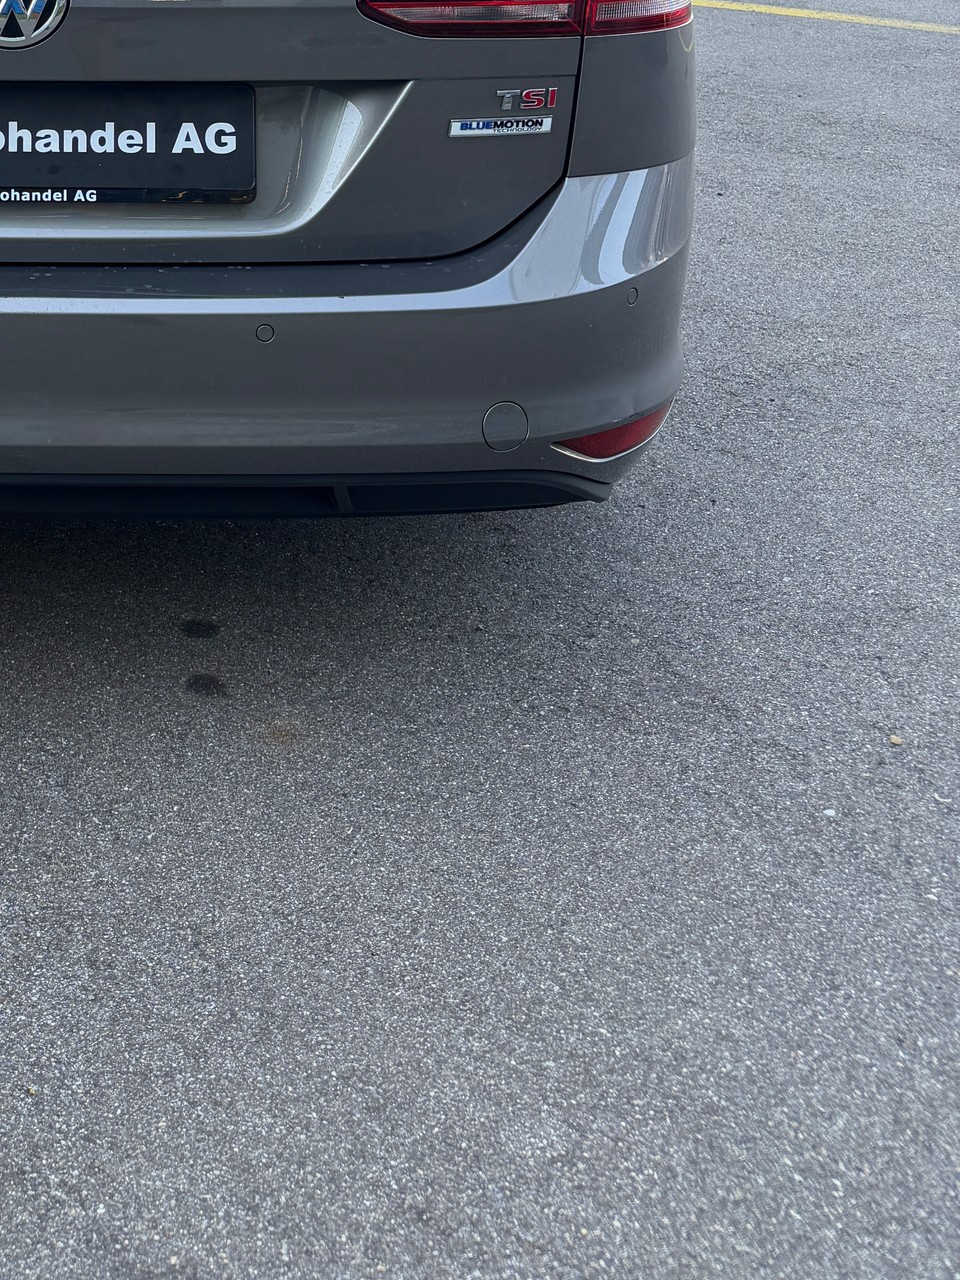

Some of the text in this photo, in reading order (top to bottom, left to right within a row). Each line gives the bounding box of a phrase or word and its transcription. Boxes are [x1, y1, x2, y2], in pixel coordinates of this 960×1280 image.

[496, 87, 558, 110] TSI
[460, 119, 543, 130] BLUEMOTION
[171, 122, 238, 155] AG
[74, 189, 98, 203] AG
